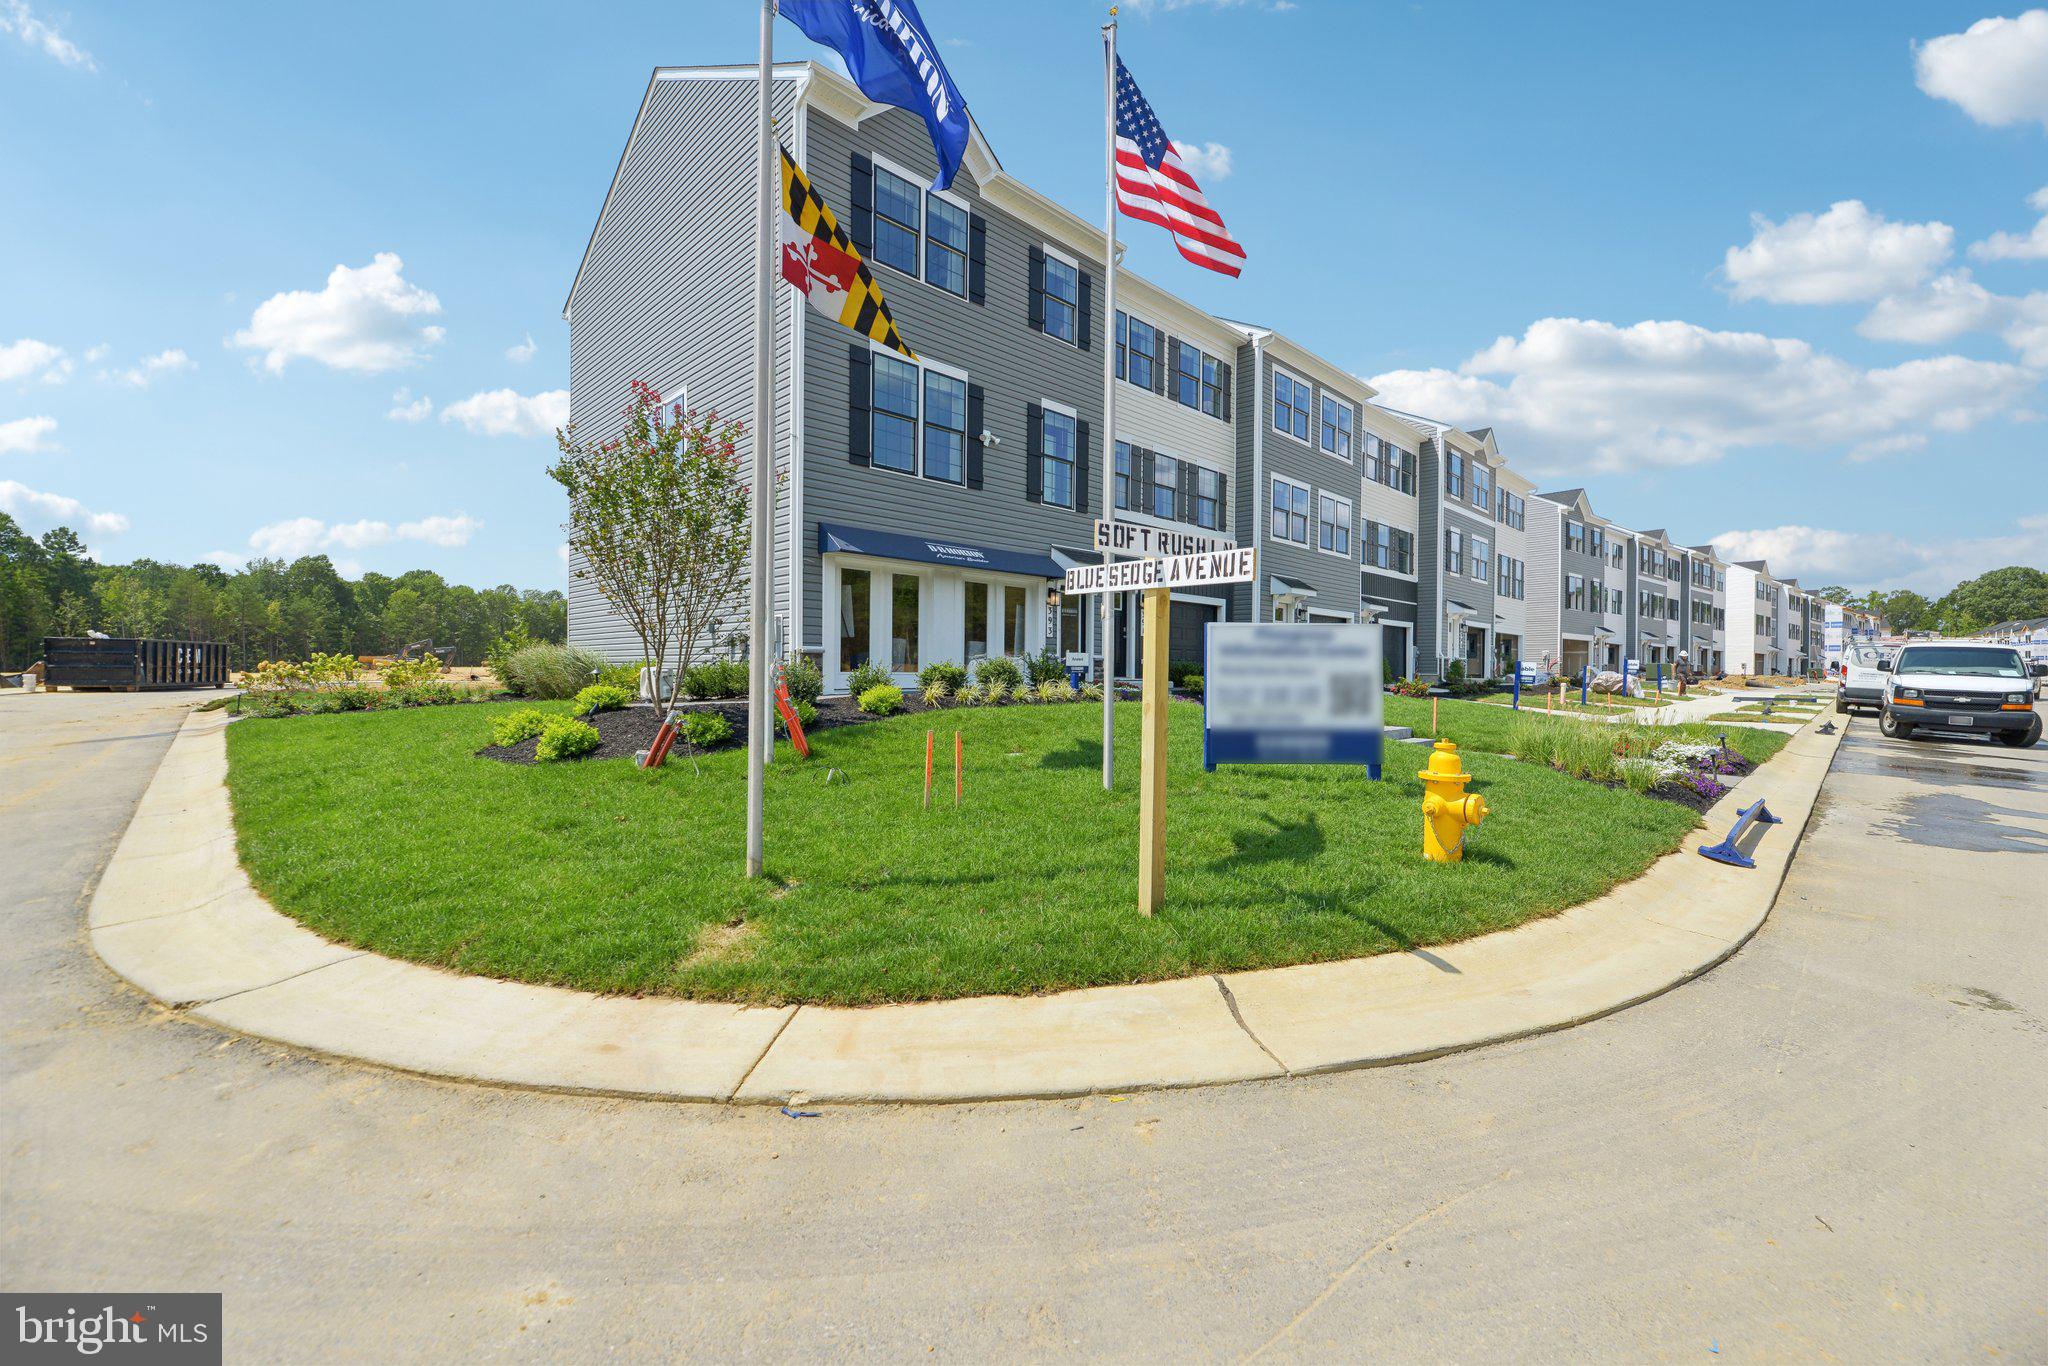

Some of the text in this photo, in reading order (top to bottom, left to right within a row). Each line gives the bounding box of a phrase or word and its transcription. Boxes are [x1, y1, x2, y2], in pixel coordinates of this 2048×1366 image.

[1098, 523, 1151, 552] SOFT
[1158, 531, 1206, 556] RUSH
[1066, 551, 1251, 590] BLUE SEDGE AVENUE
